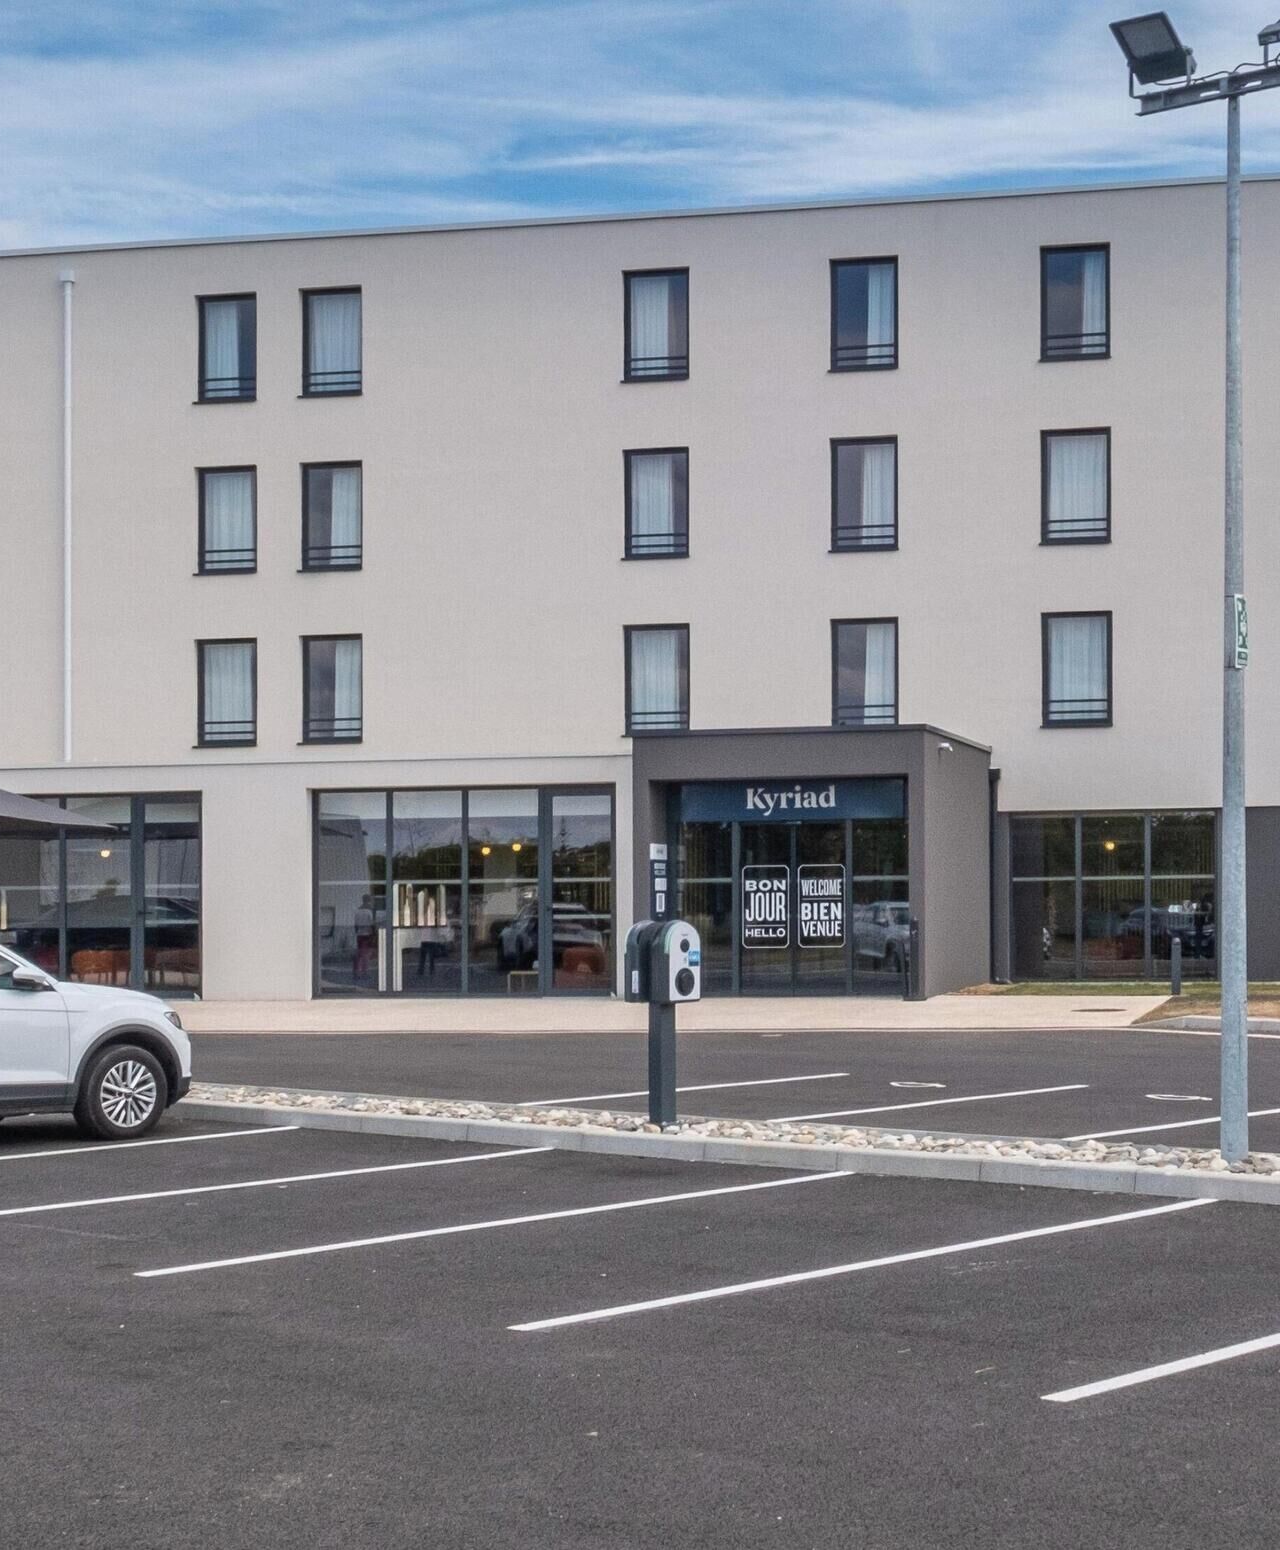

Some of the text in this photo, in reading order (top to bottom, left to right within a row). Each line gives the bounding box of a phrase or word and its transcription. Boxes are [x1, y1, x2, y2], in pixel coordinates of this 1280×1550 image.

[746, 784, 837, 816] Kyriad
[745, 880, 786, 891] BON
[801, 879, 842, 896] WELCOME
[745, 892, 786, 921] JOUR
[801, 902, 842, 920] BIEN
[745, 928, 786, 937] HELLO
[801, 921, 842, 936] VENUE
